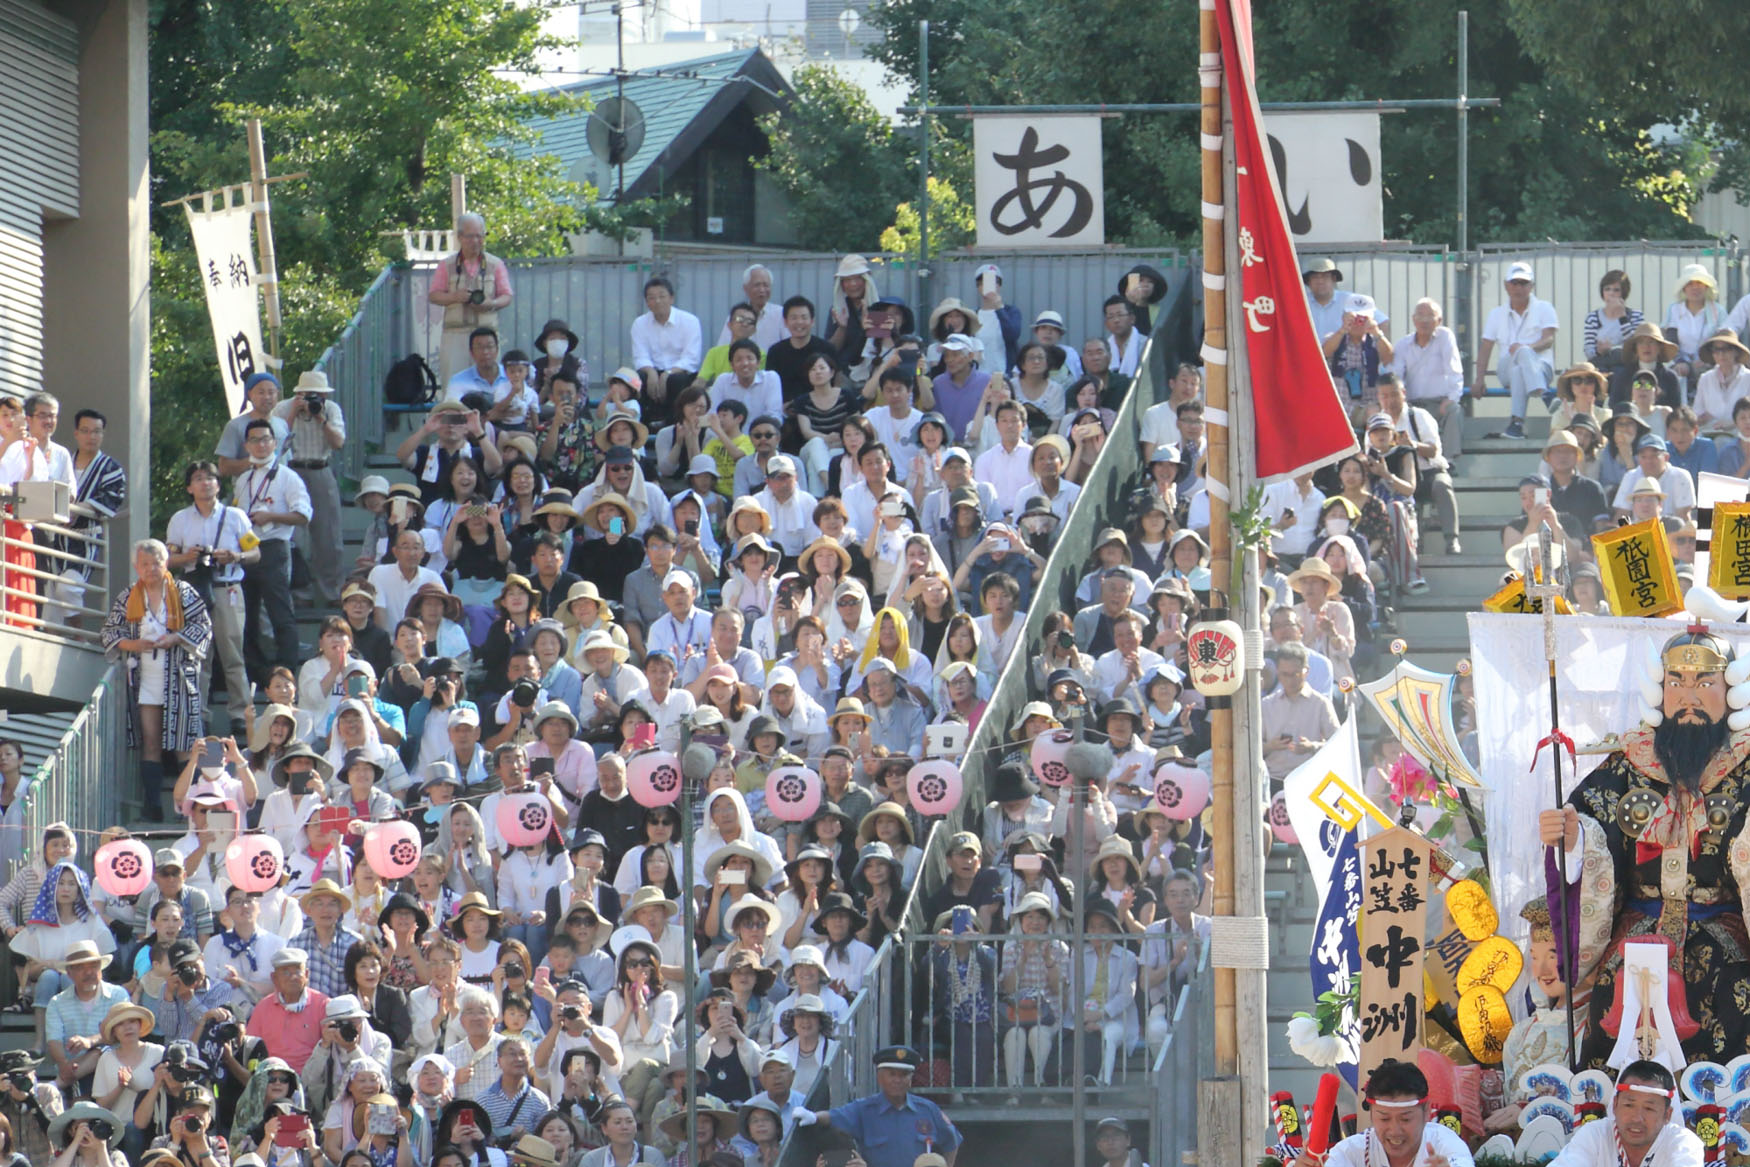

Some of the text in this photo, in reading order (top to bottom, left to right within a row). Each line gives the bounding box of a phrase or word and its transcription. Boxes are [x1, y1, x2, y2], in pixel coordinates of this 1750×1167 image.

[990, 126, 1094, 239] あ
[1614, 538, 1659, 609] 祇園宮
[1198, 638, 1219, 663] 東
[1367, 848, 1399, 915] 山笠
[1396, 847, 1425, 912] 七番
